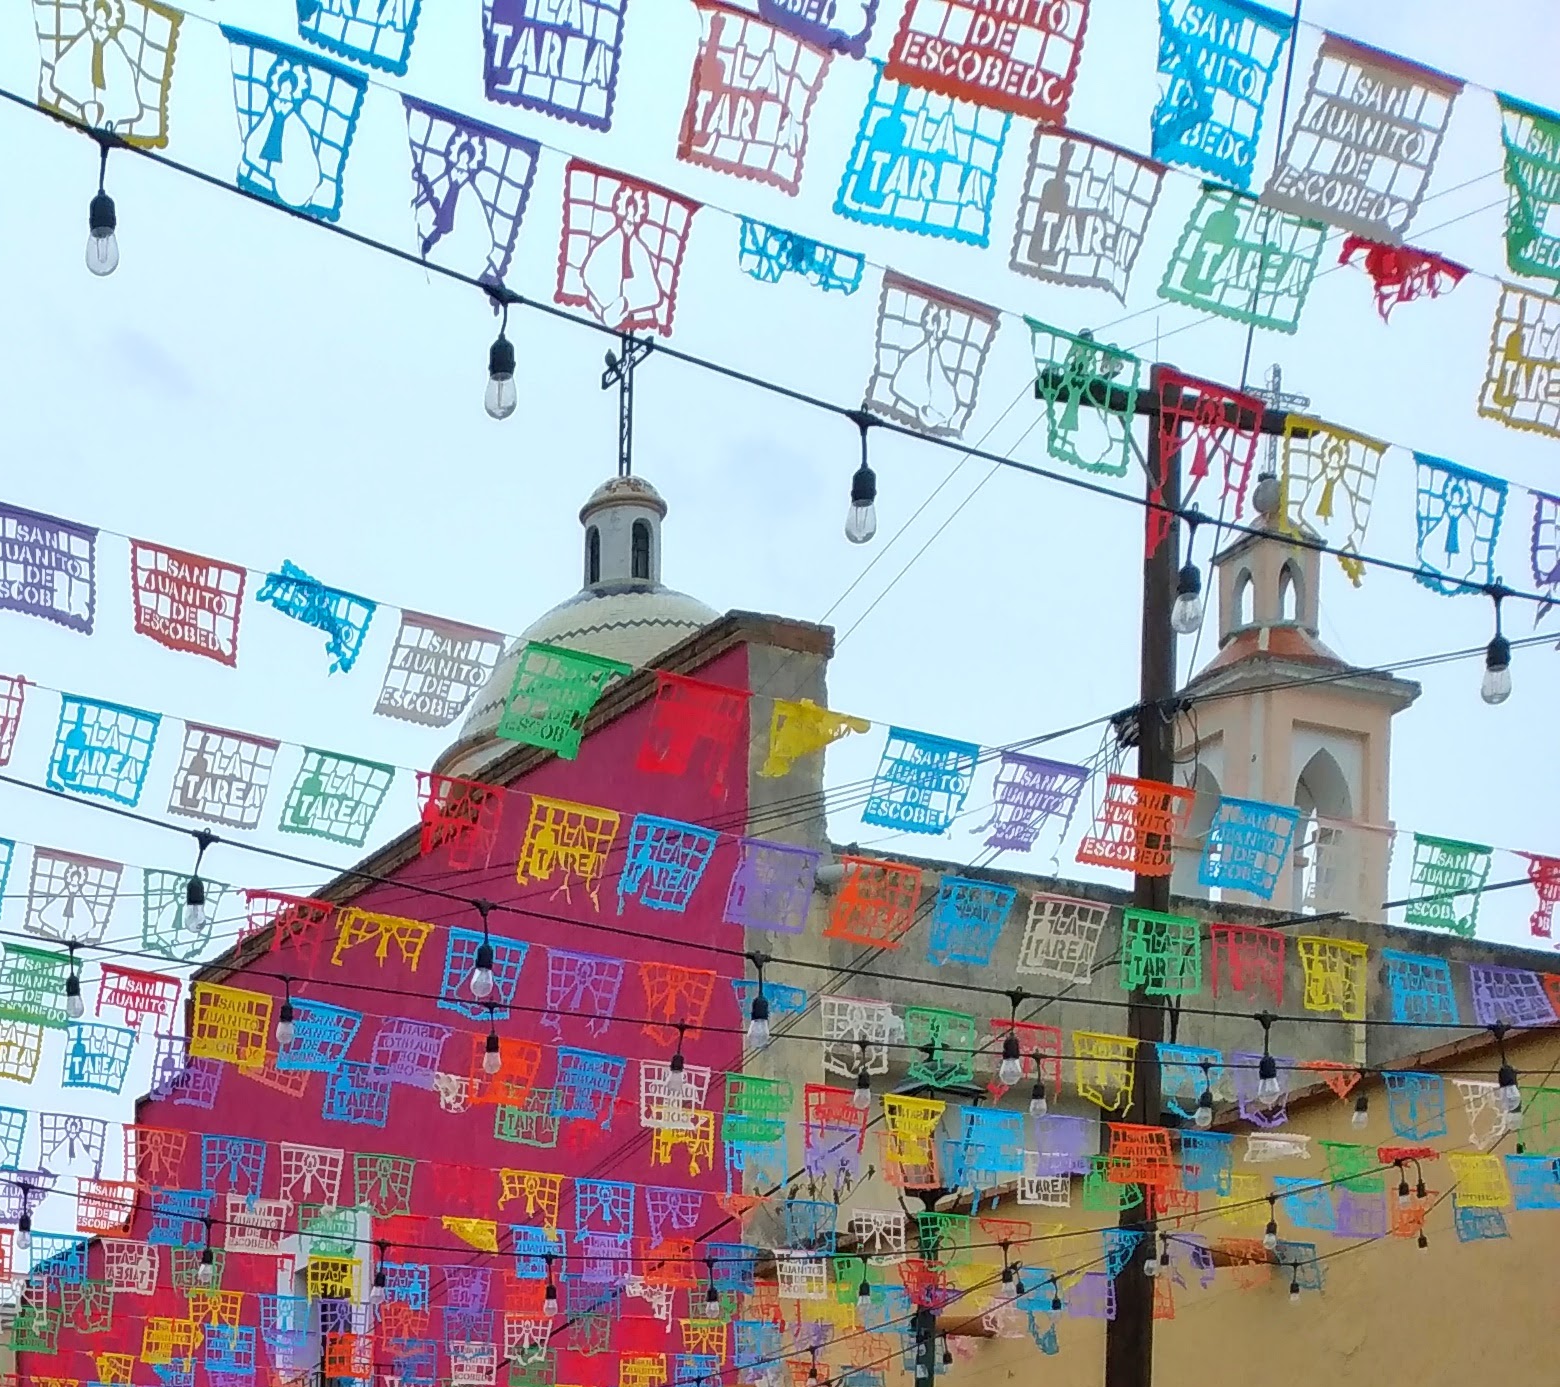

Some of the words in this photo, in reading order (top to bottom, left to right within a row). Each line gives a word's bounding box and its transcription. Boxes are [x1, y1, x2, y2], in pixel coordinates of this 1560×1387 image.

[973, 18, 1018, 50] DE
[900, 31, 1063, 106] ESCOBEDO
[1353, 77, 1411, 117] SAN
[917, 109, 958, 157] LA
[1310, 102, 1425, 160] JUANITO
[1339, 146, 1375, 180] DE
[1272, 167, 1411, 228] ESCOBEDO
[1202, 244, 1310, 305] TAREA
[17, 525, 60, 547] SAN
[26, 566, 55, 588] DE
[167, 559, 209, 583] SAN
[143, 575, 227, 614] JUANITO
[172, 600, 197, 623] DE
[428, 637, 473, 659] SAN
[399, 647, 487, 684] JUANITO
[423, 679, 450, 697] DE
[92, 722, 125, 748] LA
[66, 748, 142, 780] TAREA
[213, 751, 243, 778] LA
[910, 747, 948, 767] SAN
[325, 771, 355, 799] LA
[886, 764, 965, 794] JUANITO
[1021, 771, 1057, 791] SAN
[186, 776, 265, 808] TAREA
[905, 786, 930, 804] DE
[300, 795, 373, 825] TAREA
[1011, 807, 1033, 822] DE
[559, 824, 589, 850] LA
[1439, 853, 1467, 869] SAN
[5, 974, 66, 994] JUANITO
[126, 980, 156, 995] SAN
[106, 993, 167, 1013] JUANITO
[219, 998, 247, 1011] SAN
[204, 1009, 260, 1031] JUANITO
[89, 1034, 109, 1053] LA
[219, 1026, 240, 1040] DE
[72, 1056, 122, 1077] TAREA
